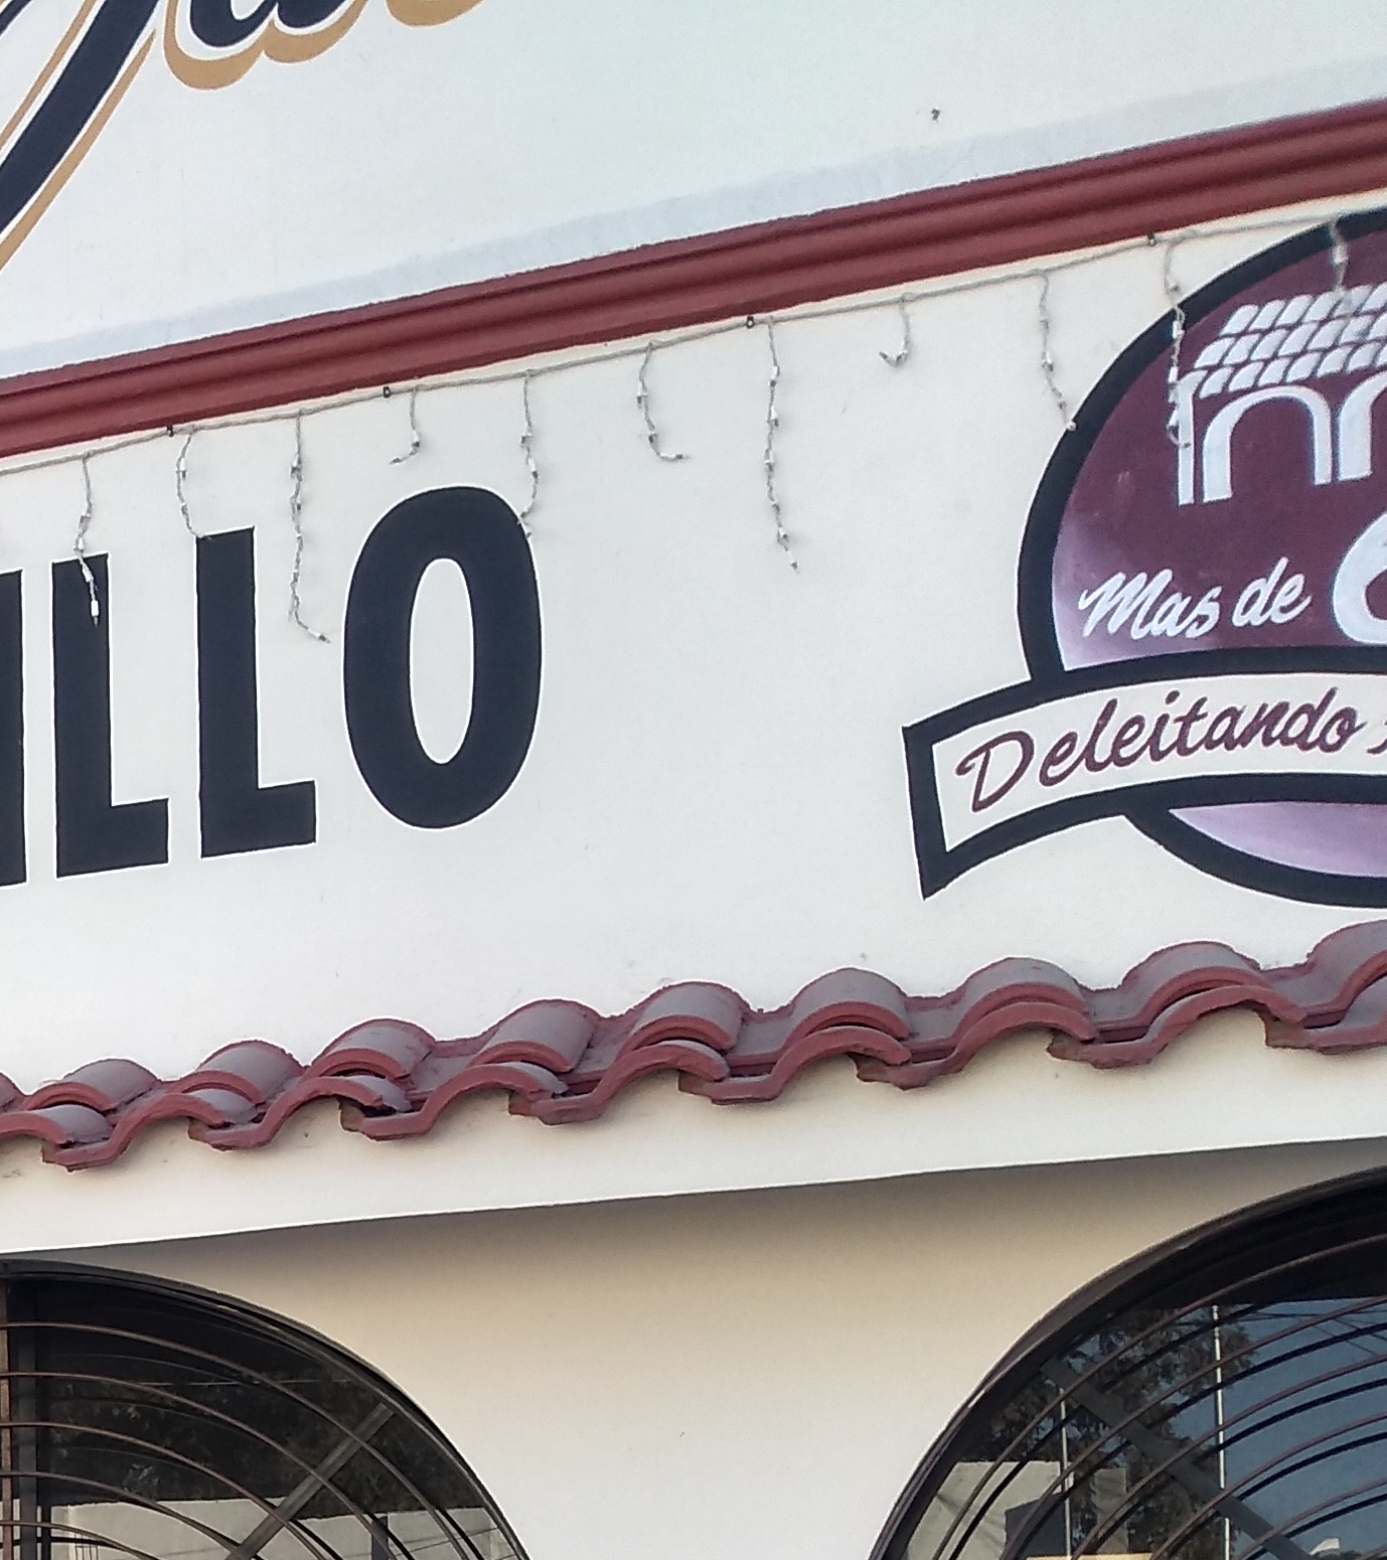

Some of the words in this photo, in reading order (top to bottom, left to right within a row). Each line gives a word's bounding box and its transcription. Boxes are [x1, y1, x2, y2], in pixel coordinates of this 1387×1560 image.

[1078, 568, 1221, 640] Mas
[1231, 555, 1313, 627] de
[955, 686, 1366, 813] Deleitando
